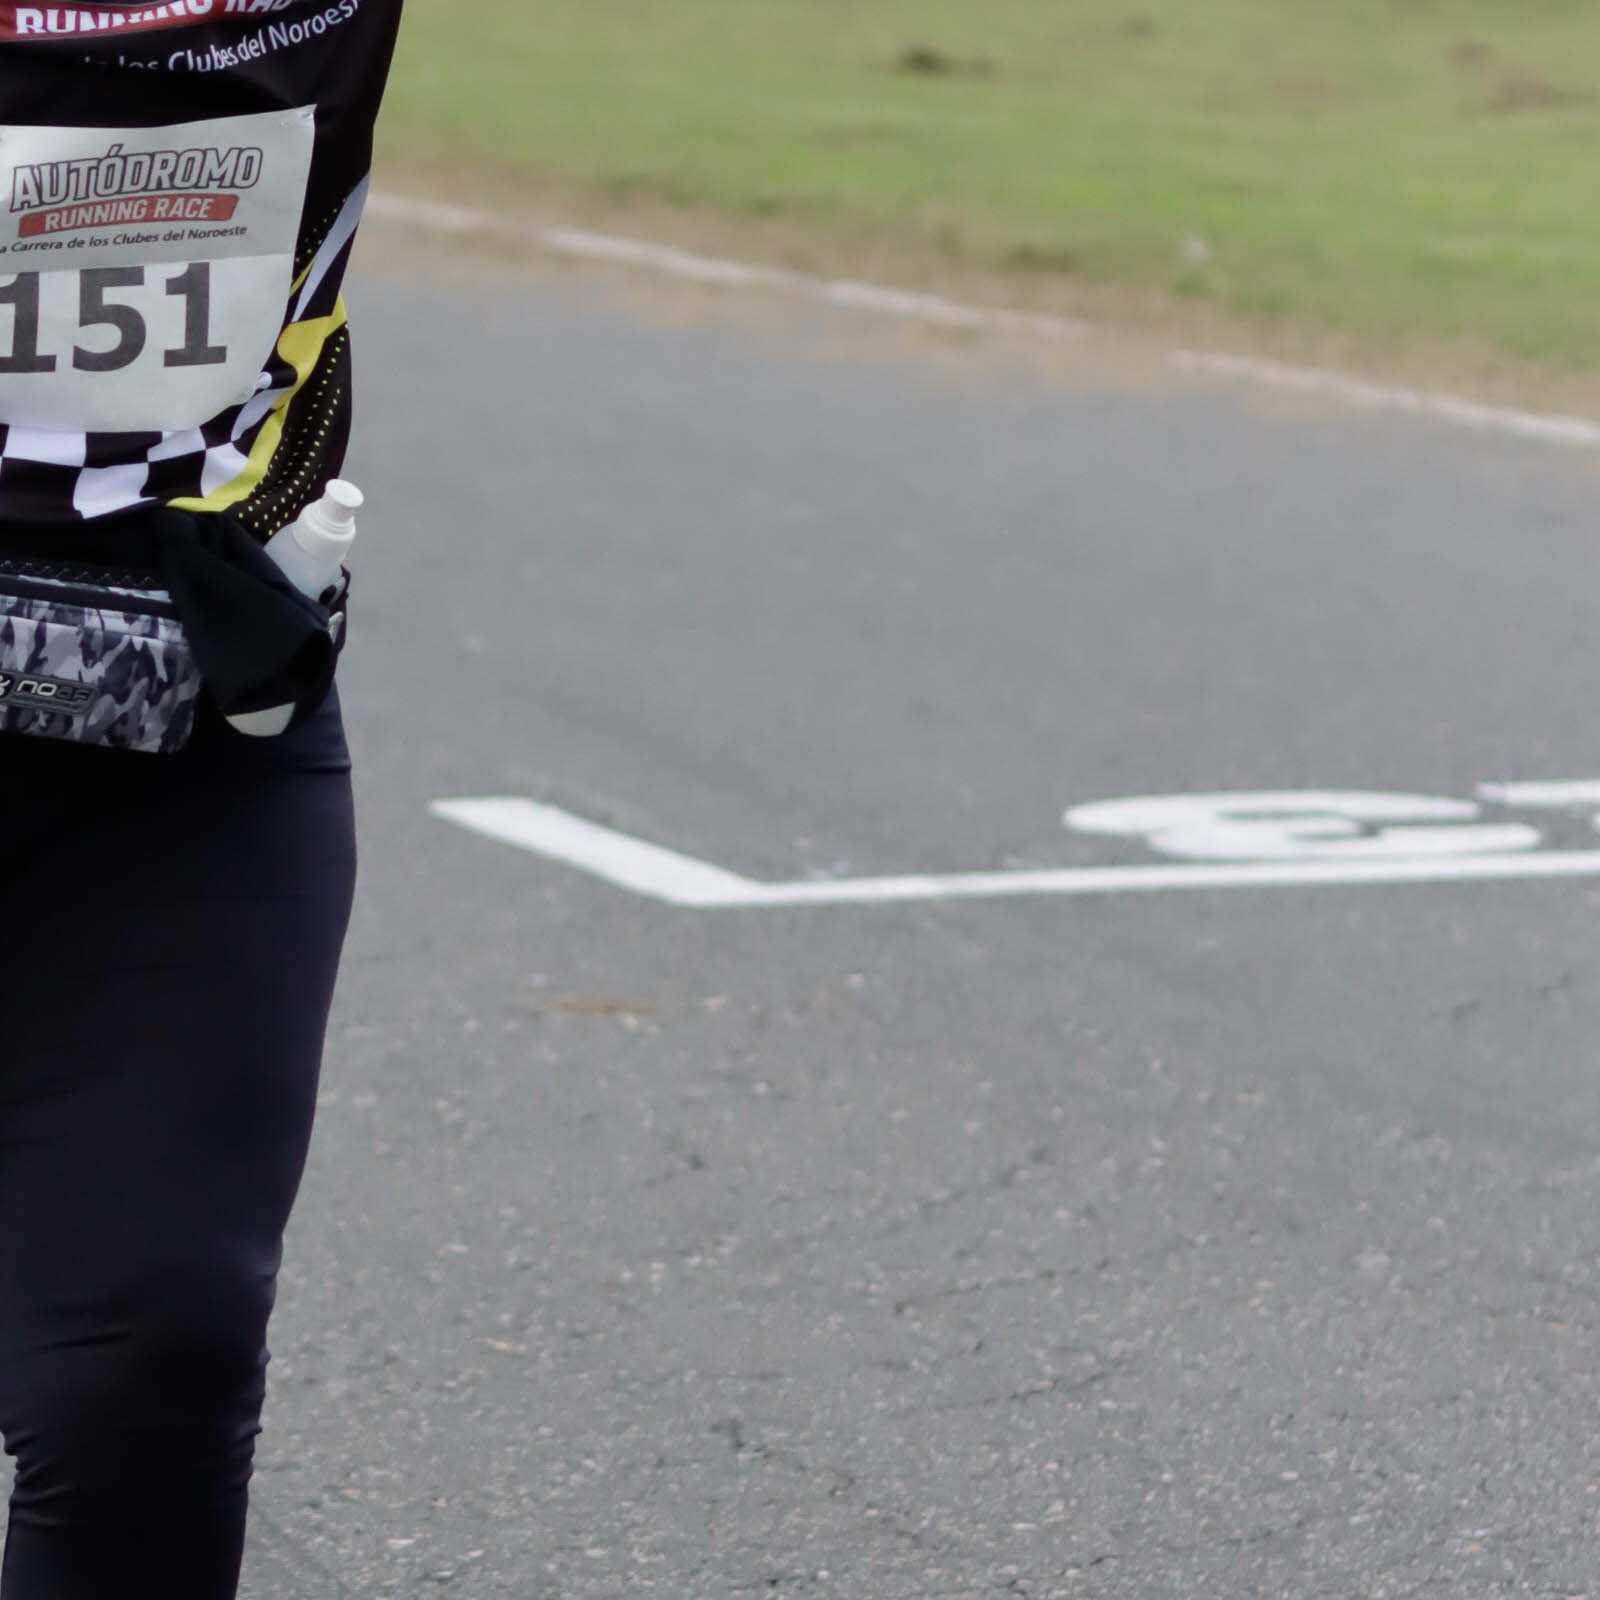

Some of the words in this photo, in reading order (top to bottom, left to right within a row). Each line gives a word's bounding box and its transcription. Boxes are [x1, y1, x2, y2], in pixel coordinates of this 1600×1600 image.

[237, 29, 268, 62] del
[9, 144, 264, 213] AUTÓDROMO
[45, 200, 149, 232] RUNNING
[153, 197, 215, 220] RACE
[11, 240, 64, 253] Carrera
[67, 237, 86, 249] de
[88, 235, 110, 247] los
[112, 232, 160, 246] Clubes
[162, 229, 186, 242] del
[187, 225, 248, 240] Noroeste
